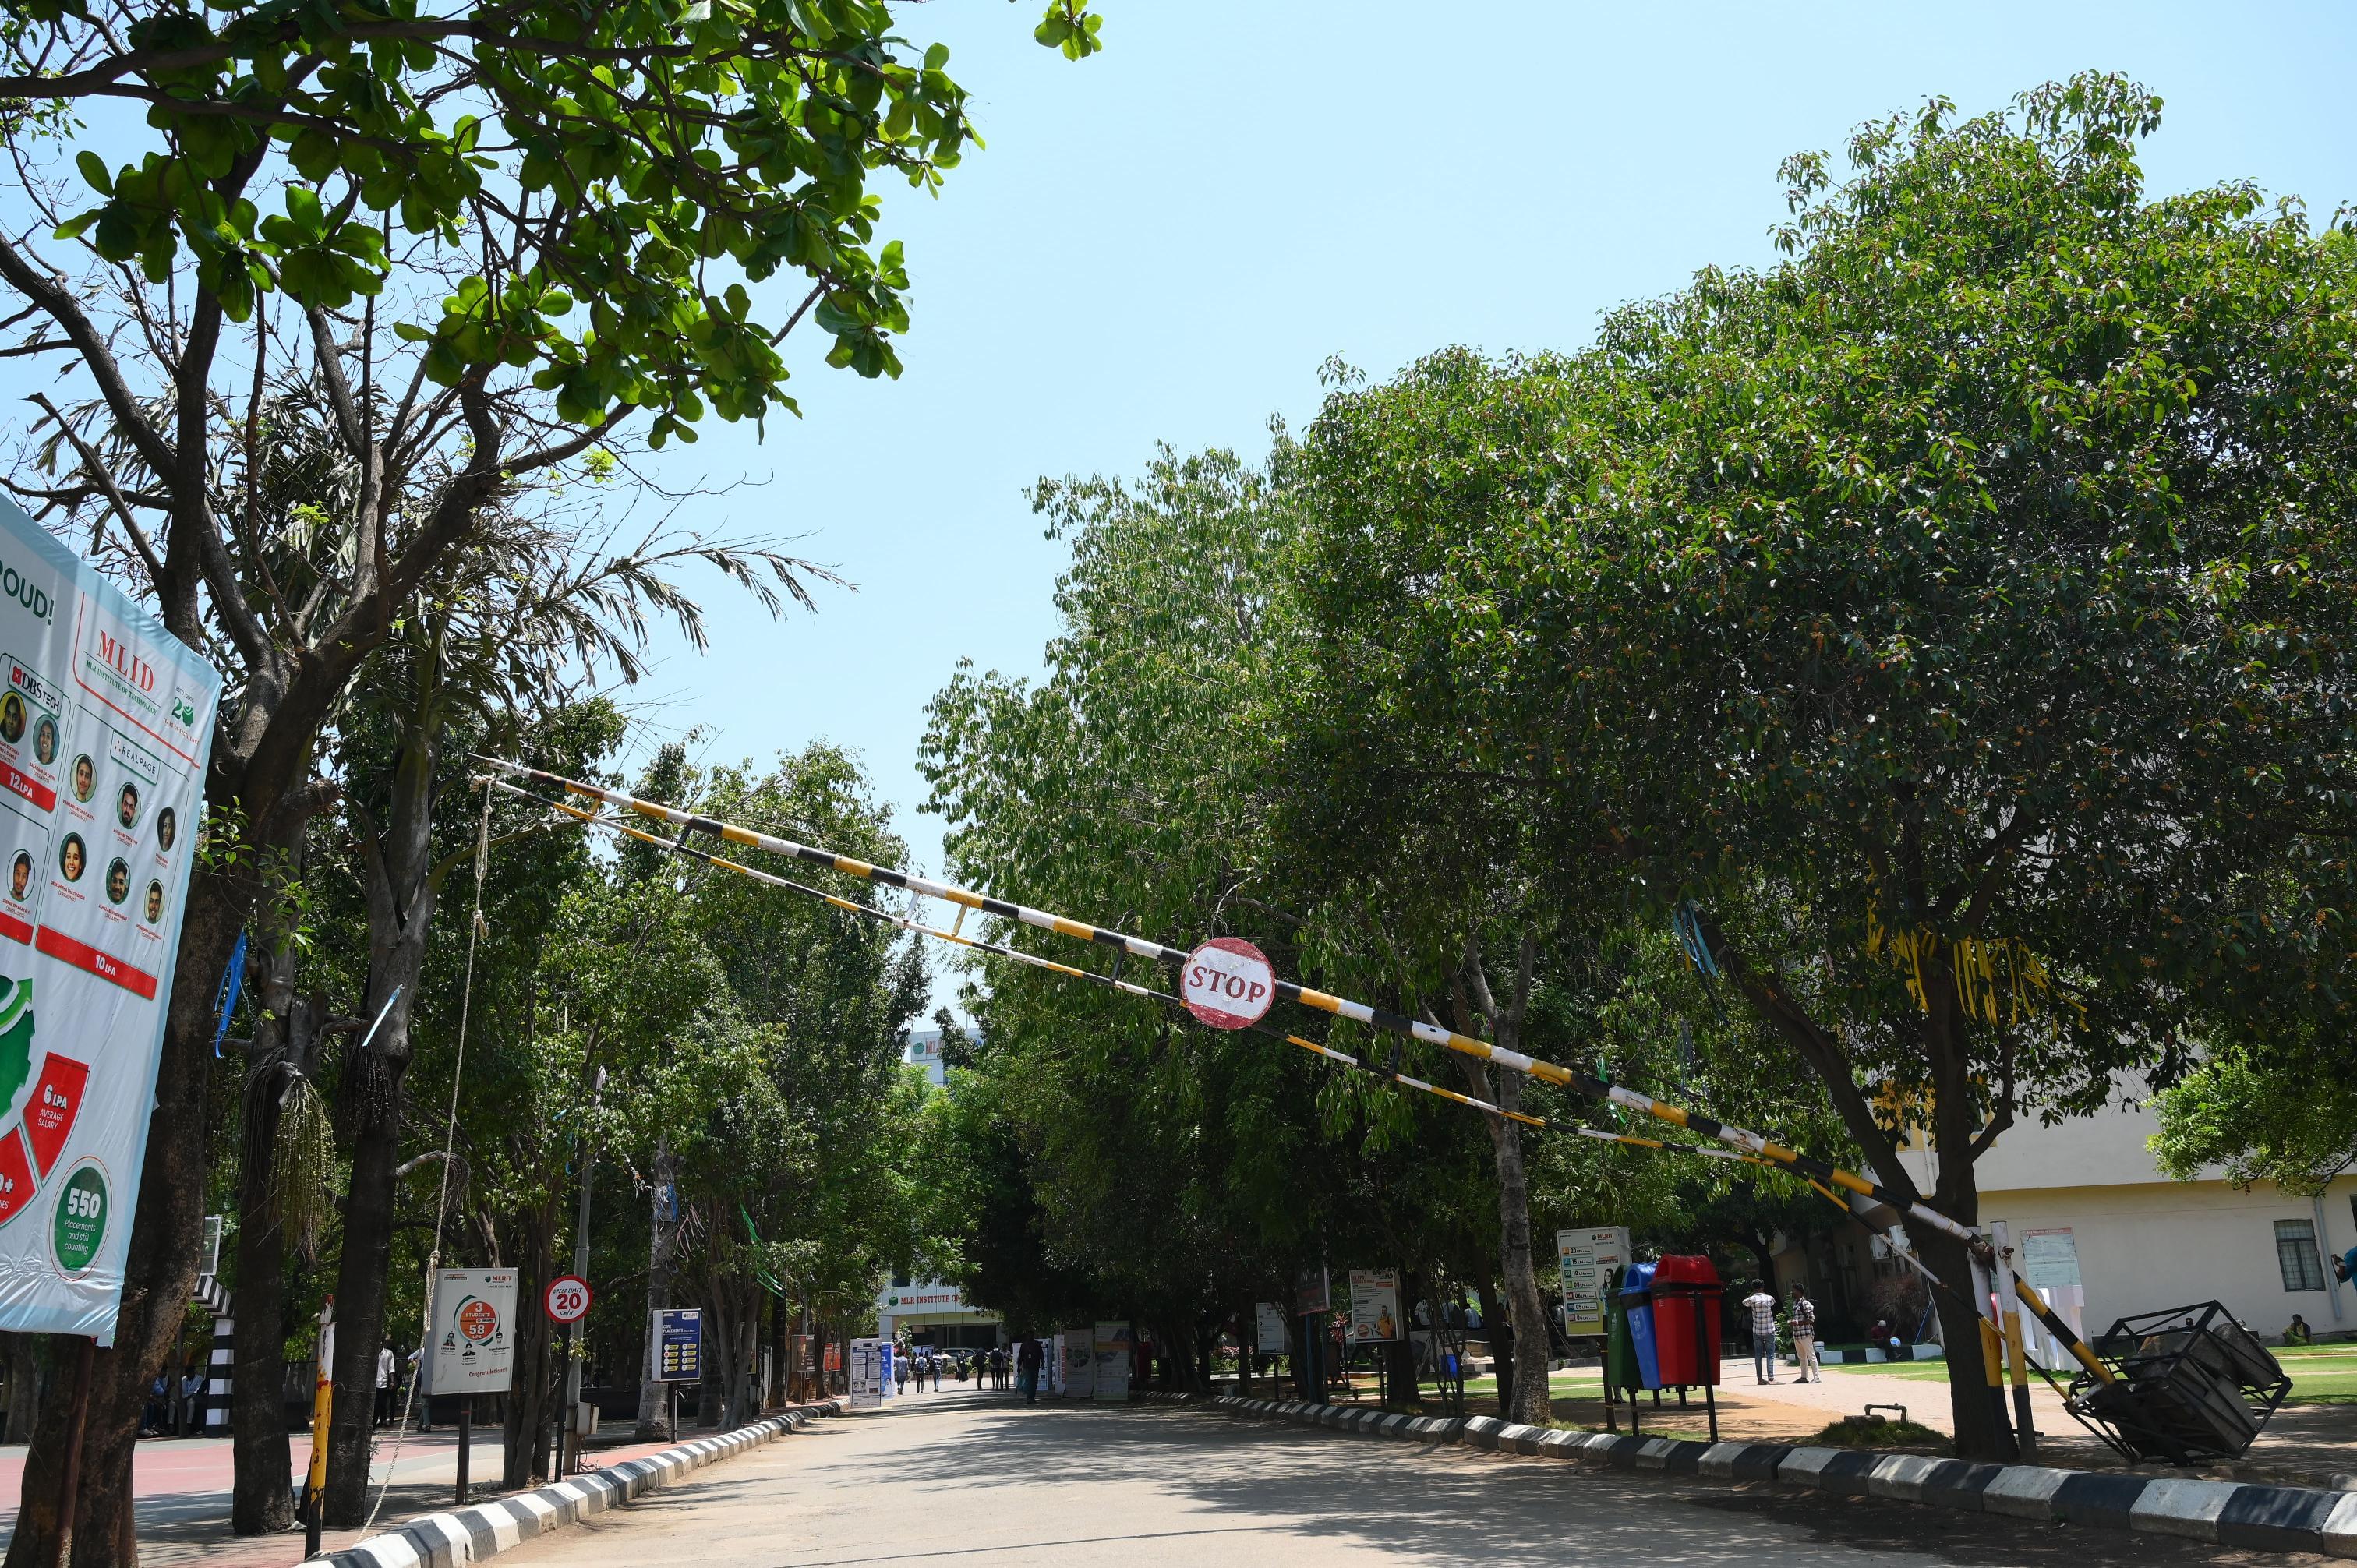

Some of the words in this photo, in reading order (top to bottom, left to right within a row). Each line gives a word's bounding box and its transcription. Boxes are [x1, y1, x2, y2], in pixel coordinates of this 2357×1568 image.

[0, 560, 54, 626] OUD!
[22, 673, 42, 698] DBS
[43, 690, 59, 712] TECH
[86, 660, 97, 675] MLR
[97, 668, 121, 690] INSTITUTE
[122, 686, 129, 696] OF
[129, 690, 157, 715] TECHNOLOGY
[122, 747, 156, 775] REALPAGE
[9, 772, 20, 789] 12
[19, 782, 33, 798] LPA
[96, 955, 105, 970] 10
[105, 966, 115, 976] LPA
[1189, 966, 1266, 1004] STOP
[44, 1084, 53, 1104] 6
[52, 1094, 68, 1110] LPA
[38, 1118, 58, 1130] SALARY
[40, 1109, 64, 1122] AVERAGE
[68, 1188, 101, 1219] 550
[65, 1219, 96, 1232] Placements
[68, 1232, 80, 1241] and
[80, 1233, 89, 1241] still
[64, 1242, 89, 1255] counting
[475, 1302, 482, 1312] 3
[557, 1293, 581, 1310] 20
[900, 1296, 915, 1305] MLR
[917, 1294, 950, 1304] INSTITUTE
[469, 1324, 485, 1335] 58
